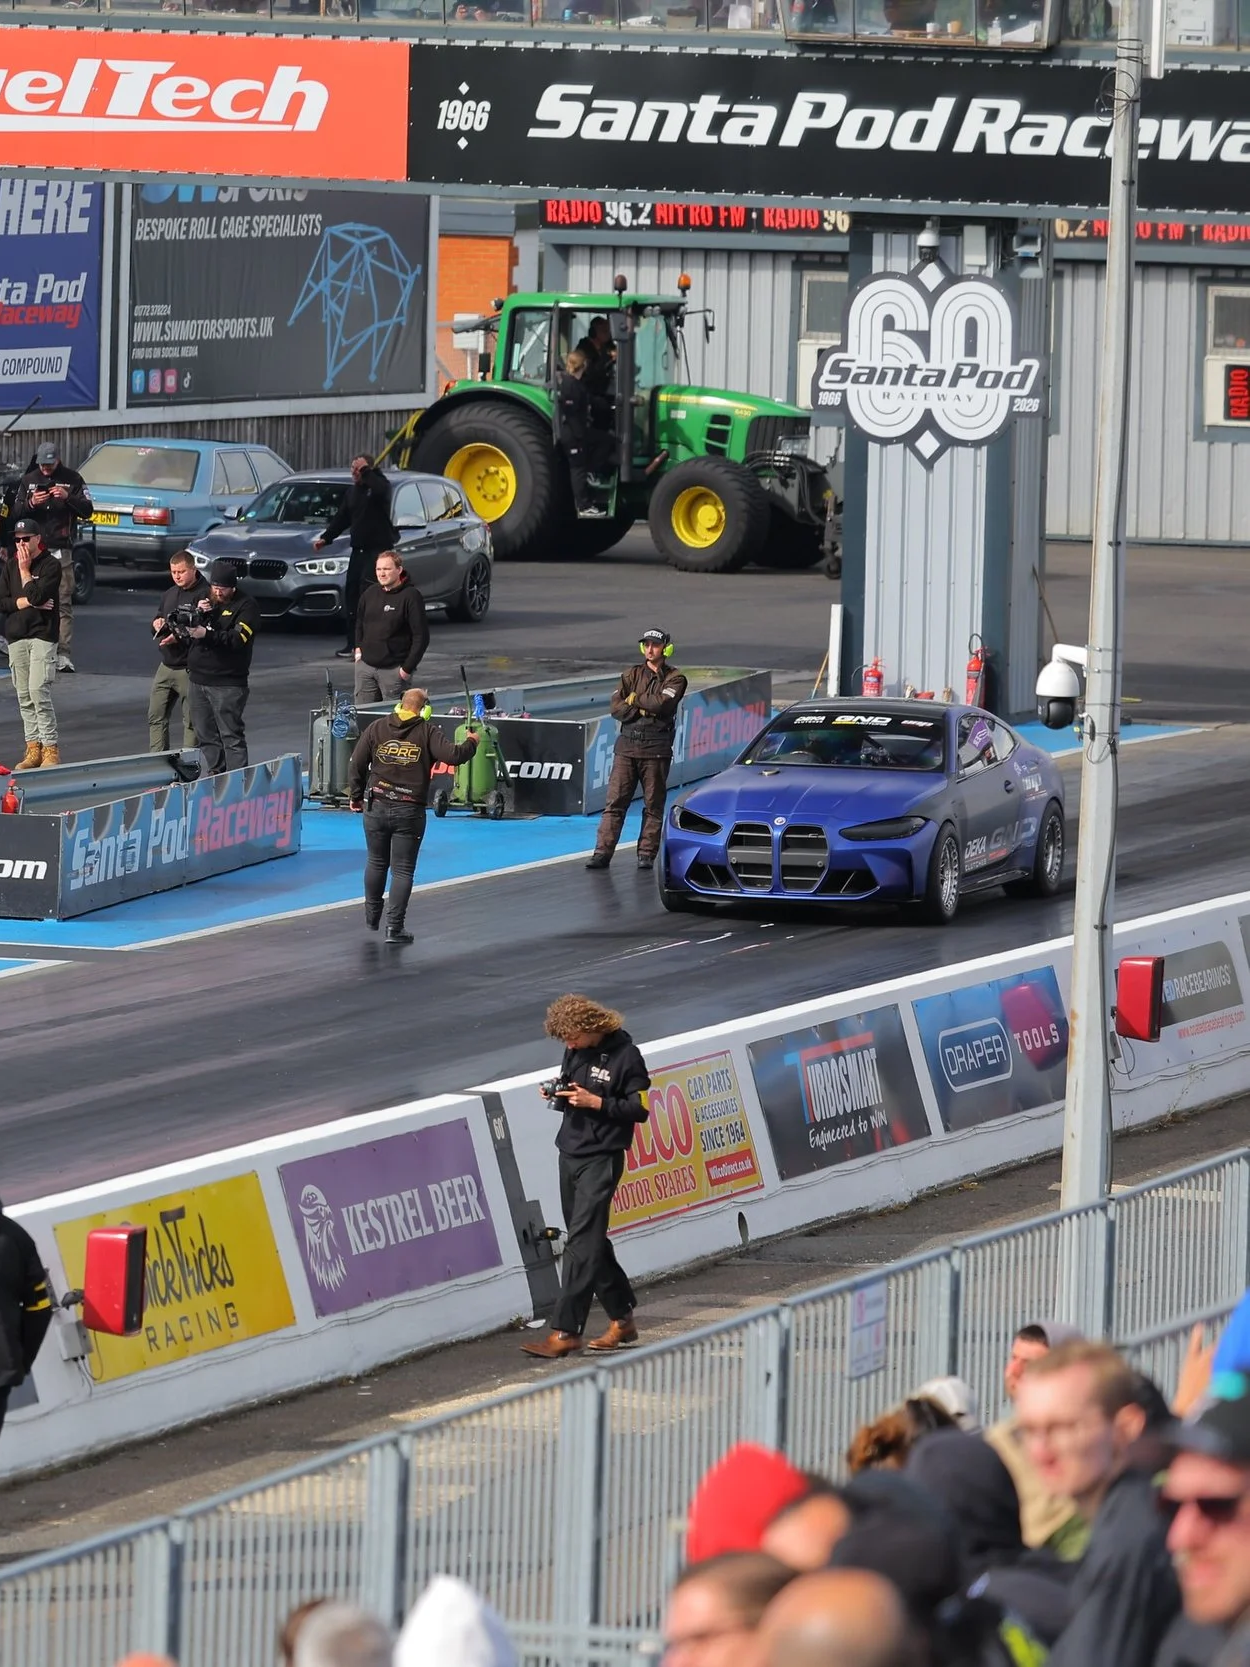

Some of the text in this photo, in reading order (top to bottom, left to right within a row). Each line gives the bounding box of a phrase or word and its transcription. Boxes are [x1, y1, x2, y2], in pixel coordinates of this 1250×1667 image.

[437, 100, 491, 131] 1966
[527, 84, 1250, 161] Santa Pod Racewa
[135, 213, 322, 240] BESPOKE ROLL CAGE SPECIALISTS
[547, 200, 746, 227] RADIO 96.2 NITRO FM
[764, 207, 850, 233] RADIO 96
[1054, 218, 1088, 239] 6.2
[34, 272, 88, 304] Pod
[133, 317, 275, 342] WWW.SWMOTORSPORTS.UK
[2, 356, 63, 377] COMPOUND
[824, 358, 1034, 390] Santa Pod
[817, 391, 842, 406] 1966
[882, 391, 975, 403] RACEWAY
[1012, 398, 1040, 413] 2026
[1229, 368, 1249, 418] RADIO
[100, 513, 118, 523] GNV
[378, 747, 419, 757] SPRC
[70, 790, 294, 890] Santa Pod Raceway
[964, 836, 987, 859] DEKA
[944, 1023, 1060, 1076] DRAPER TOOLS
[687, 1068, 731, 1101] CAR PARTS
[784, 1031, 883, 1124] TURBOSMART
[694, 1098, 738, 1123] & ACCESSORIES
[700, 1120, 746, 1152] SINCE 1964
[809, 1110, 888, 1151] Engineered to WIN
[613, 1165, 697, 1213] MOTOR SPARES
[341, 1174, 485, 1255] KESTREL BEER
[145, 1302, 239, 1352] RACING
